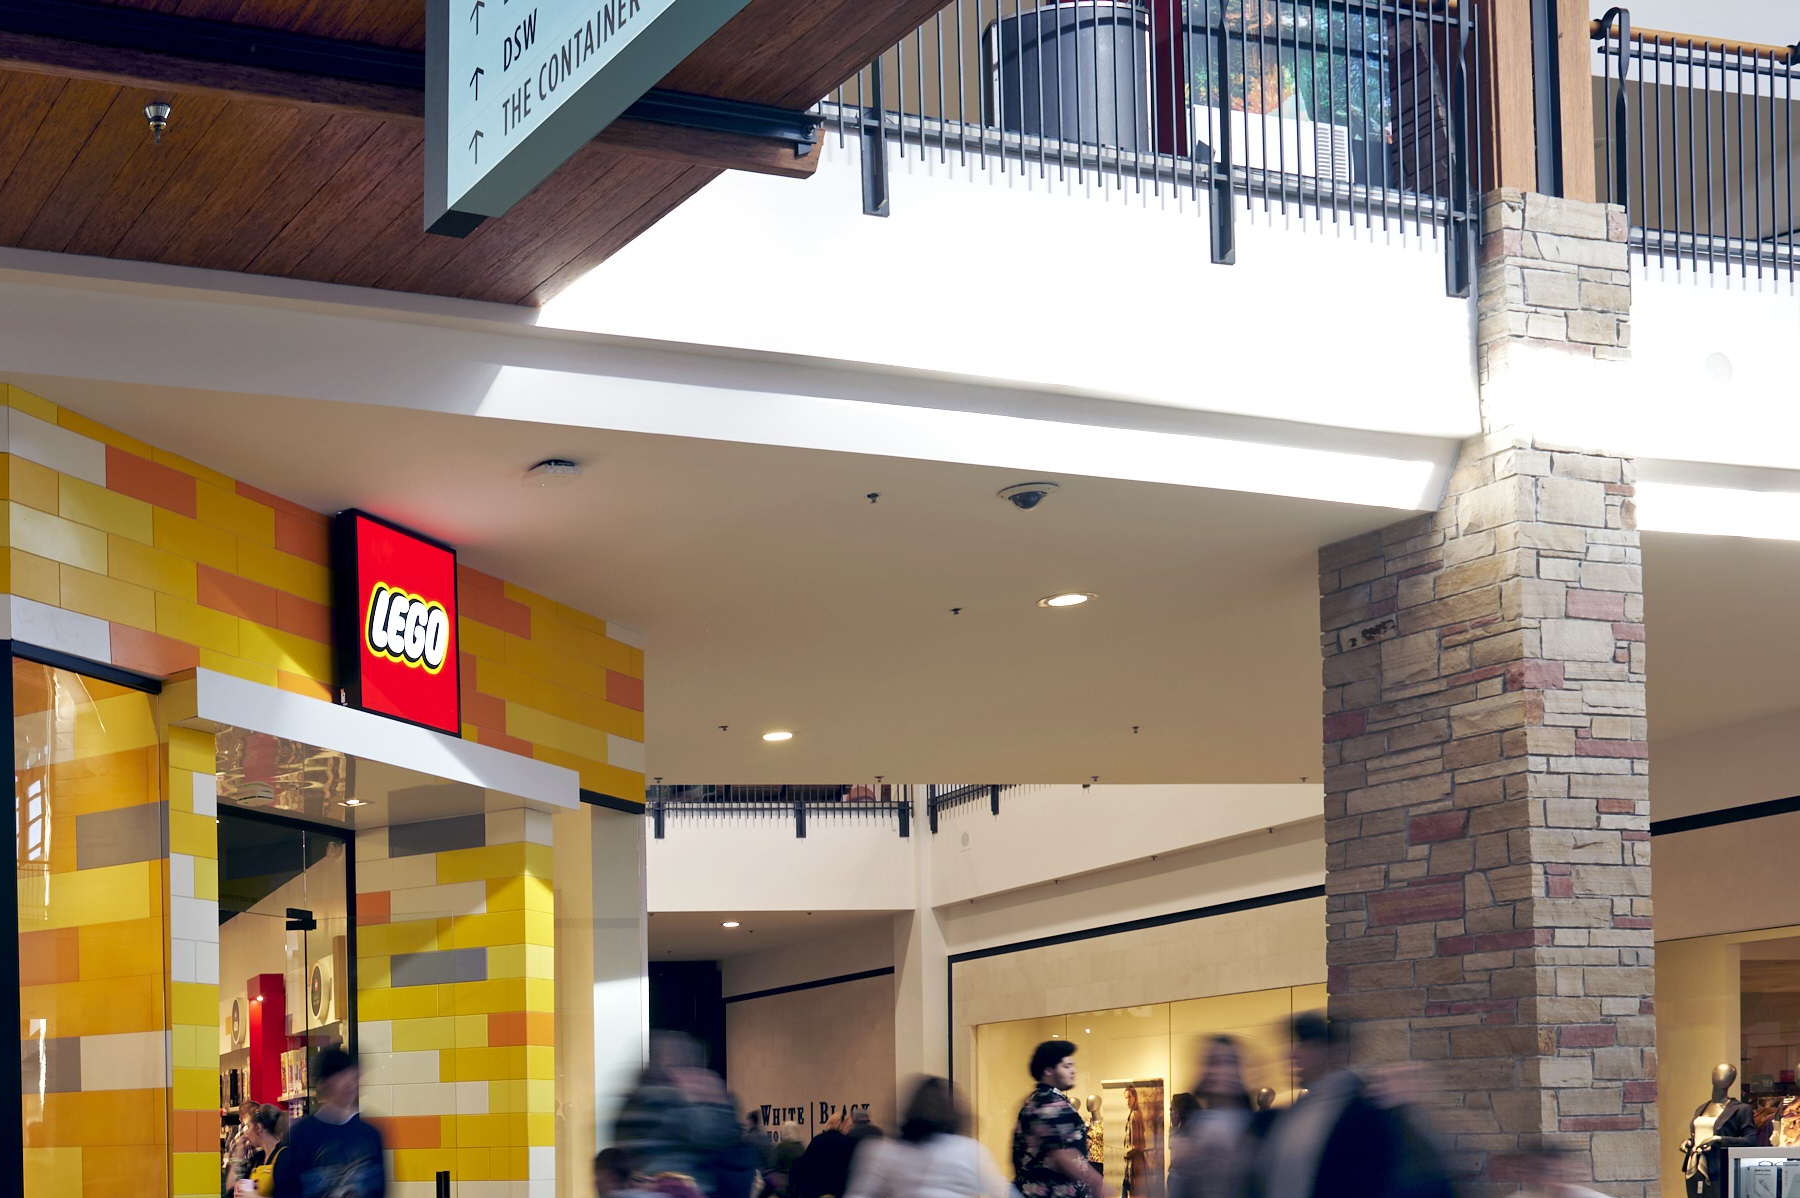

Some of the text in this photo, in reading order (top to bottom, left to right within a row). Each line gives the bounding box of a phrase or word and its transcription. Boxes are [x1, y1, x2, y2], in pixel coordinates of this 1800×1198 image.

[503, 8, 537, 72] DSW
[502, 77, 532, 136] THE
[367, 584, 449, 672] LEGO
[760, 1104, 805, 1126] WHITE
